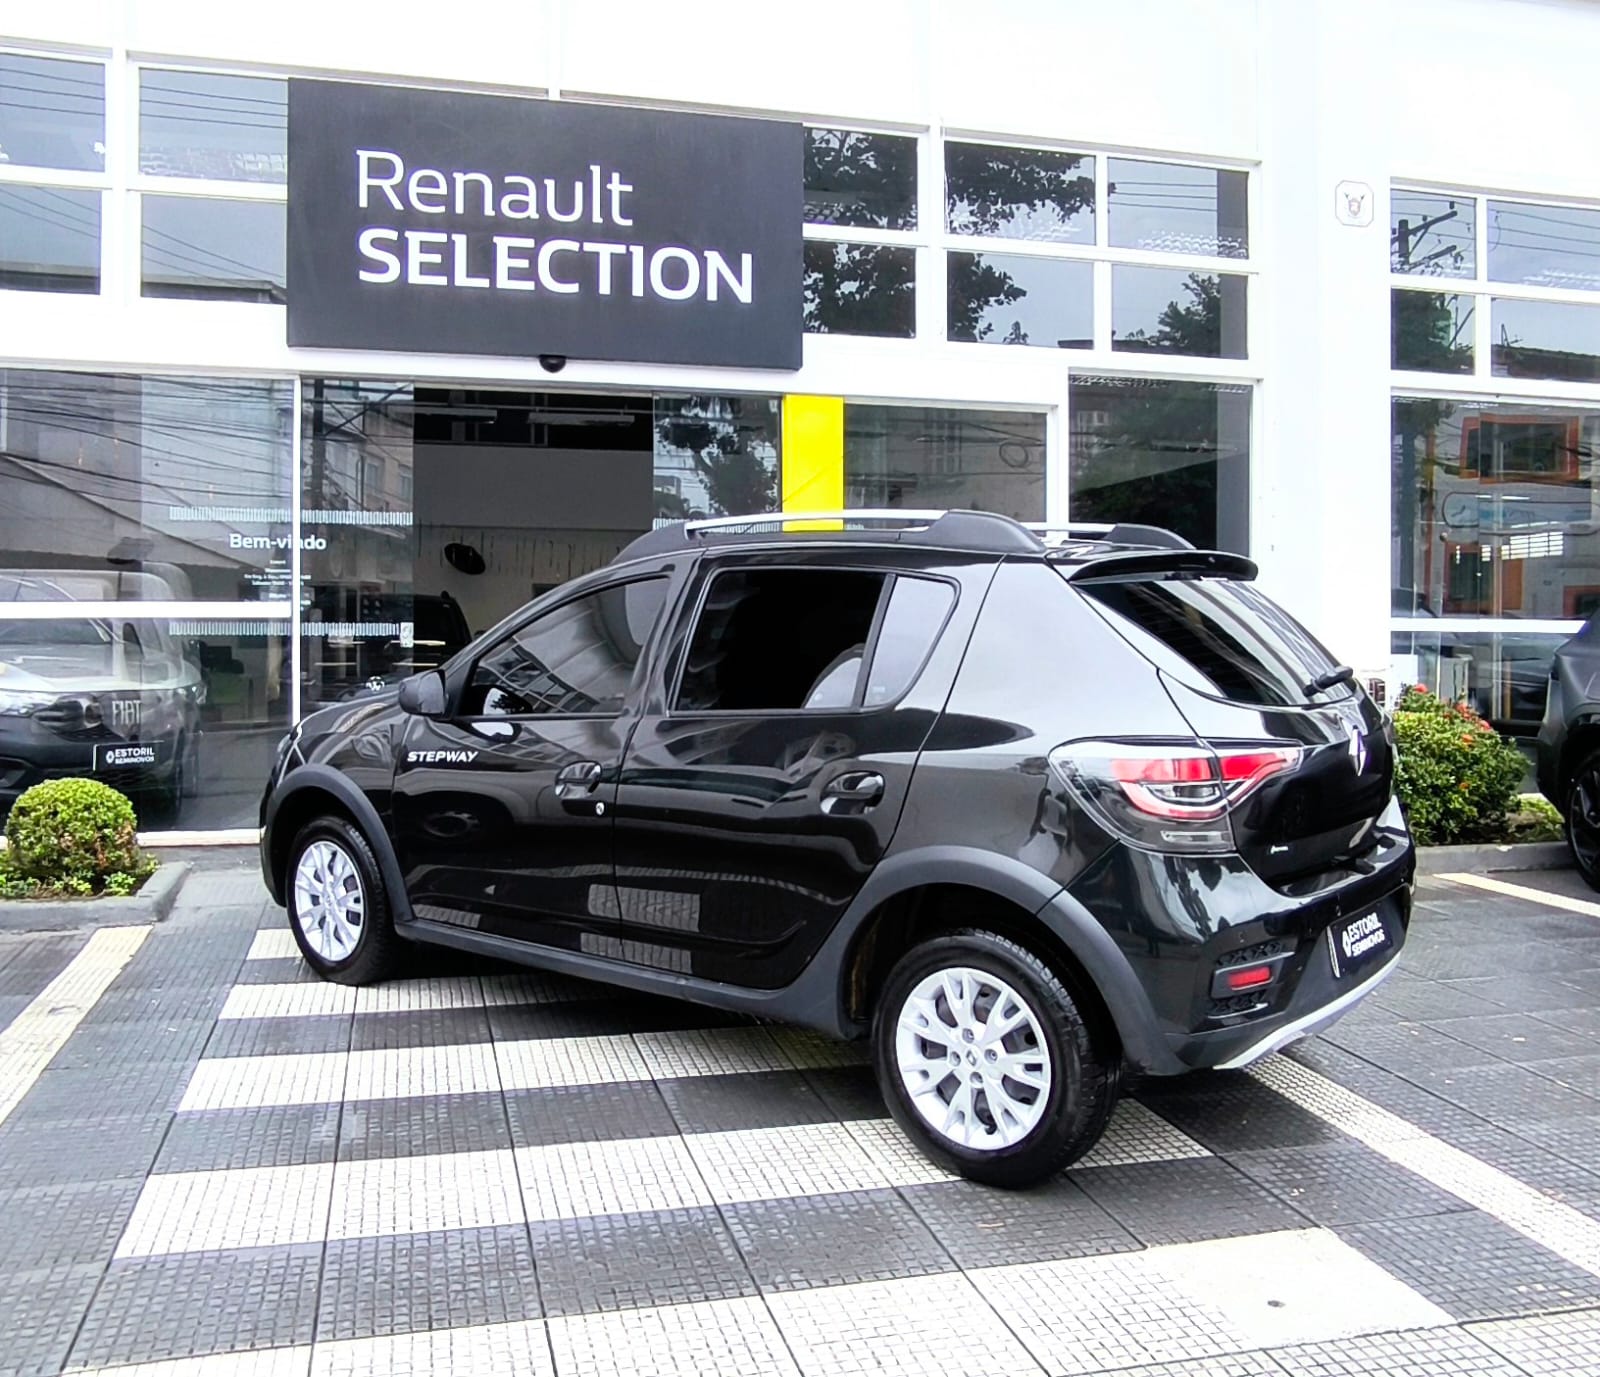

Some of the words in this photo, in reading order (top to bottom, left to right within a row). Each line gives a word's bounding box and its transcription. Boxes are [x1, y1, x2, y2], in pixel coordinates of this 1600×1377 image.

[356, 149, 633, 226] Renault
[358, 228, 753, 304] SELECTION
[112, 700, 141, 726] FIAT
[115, 747, 155, 757] ESTORIL
[407, 750, 478, 762] STEPWAY
[1347, 912, 1382, 943] ESTORIL
